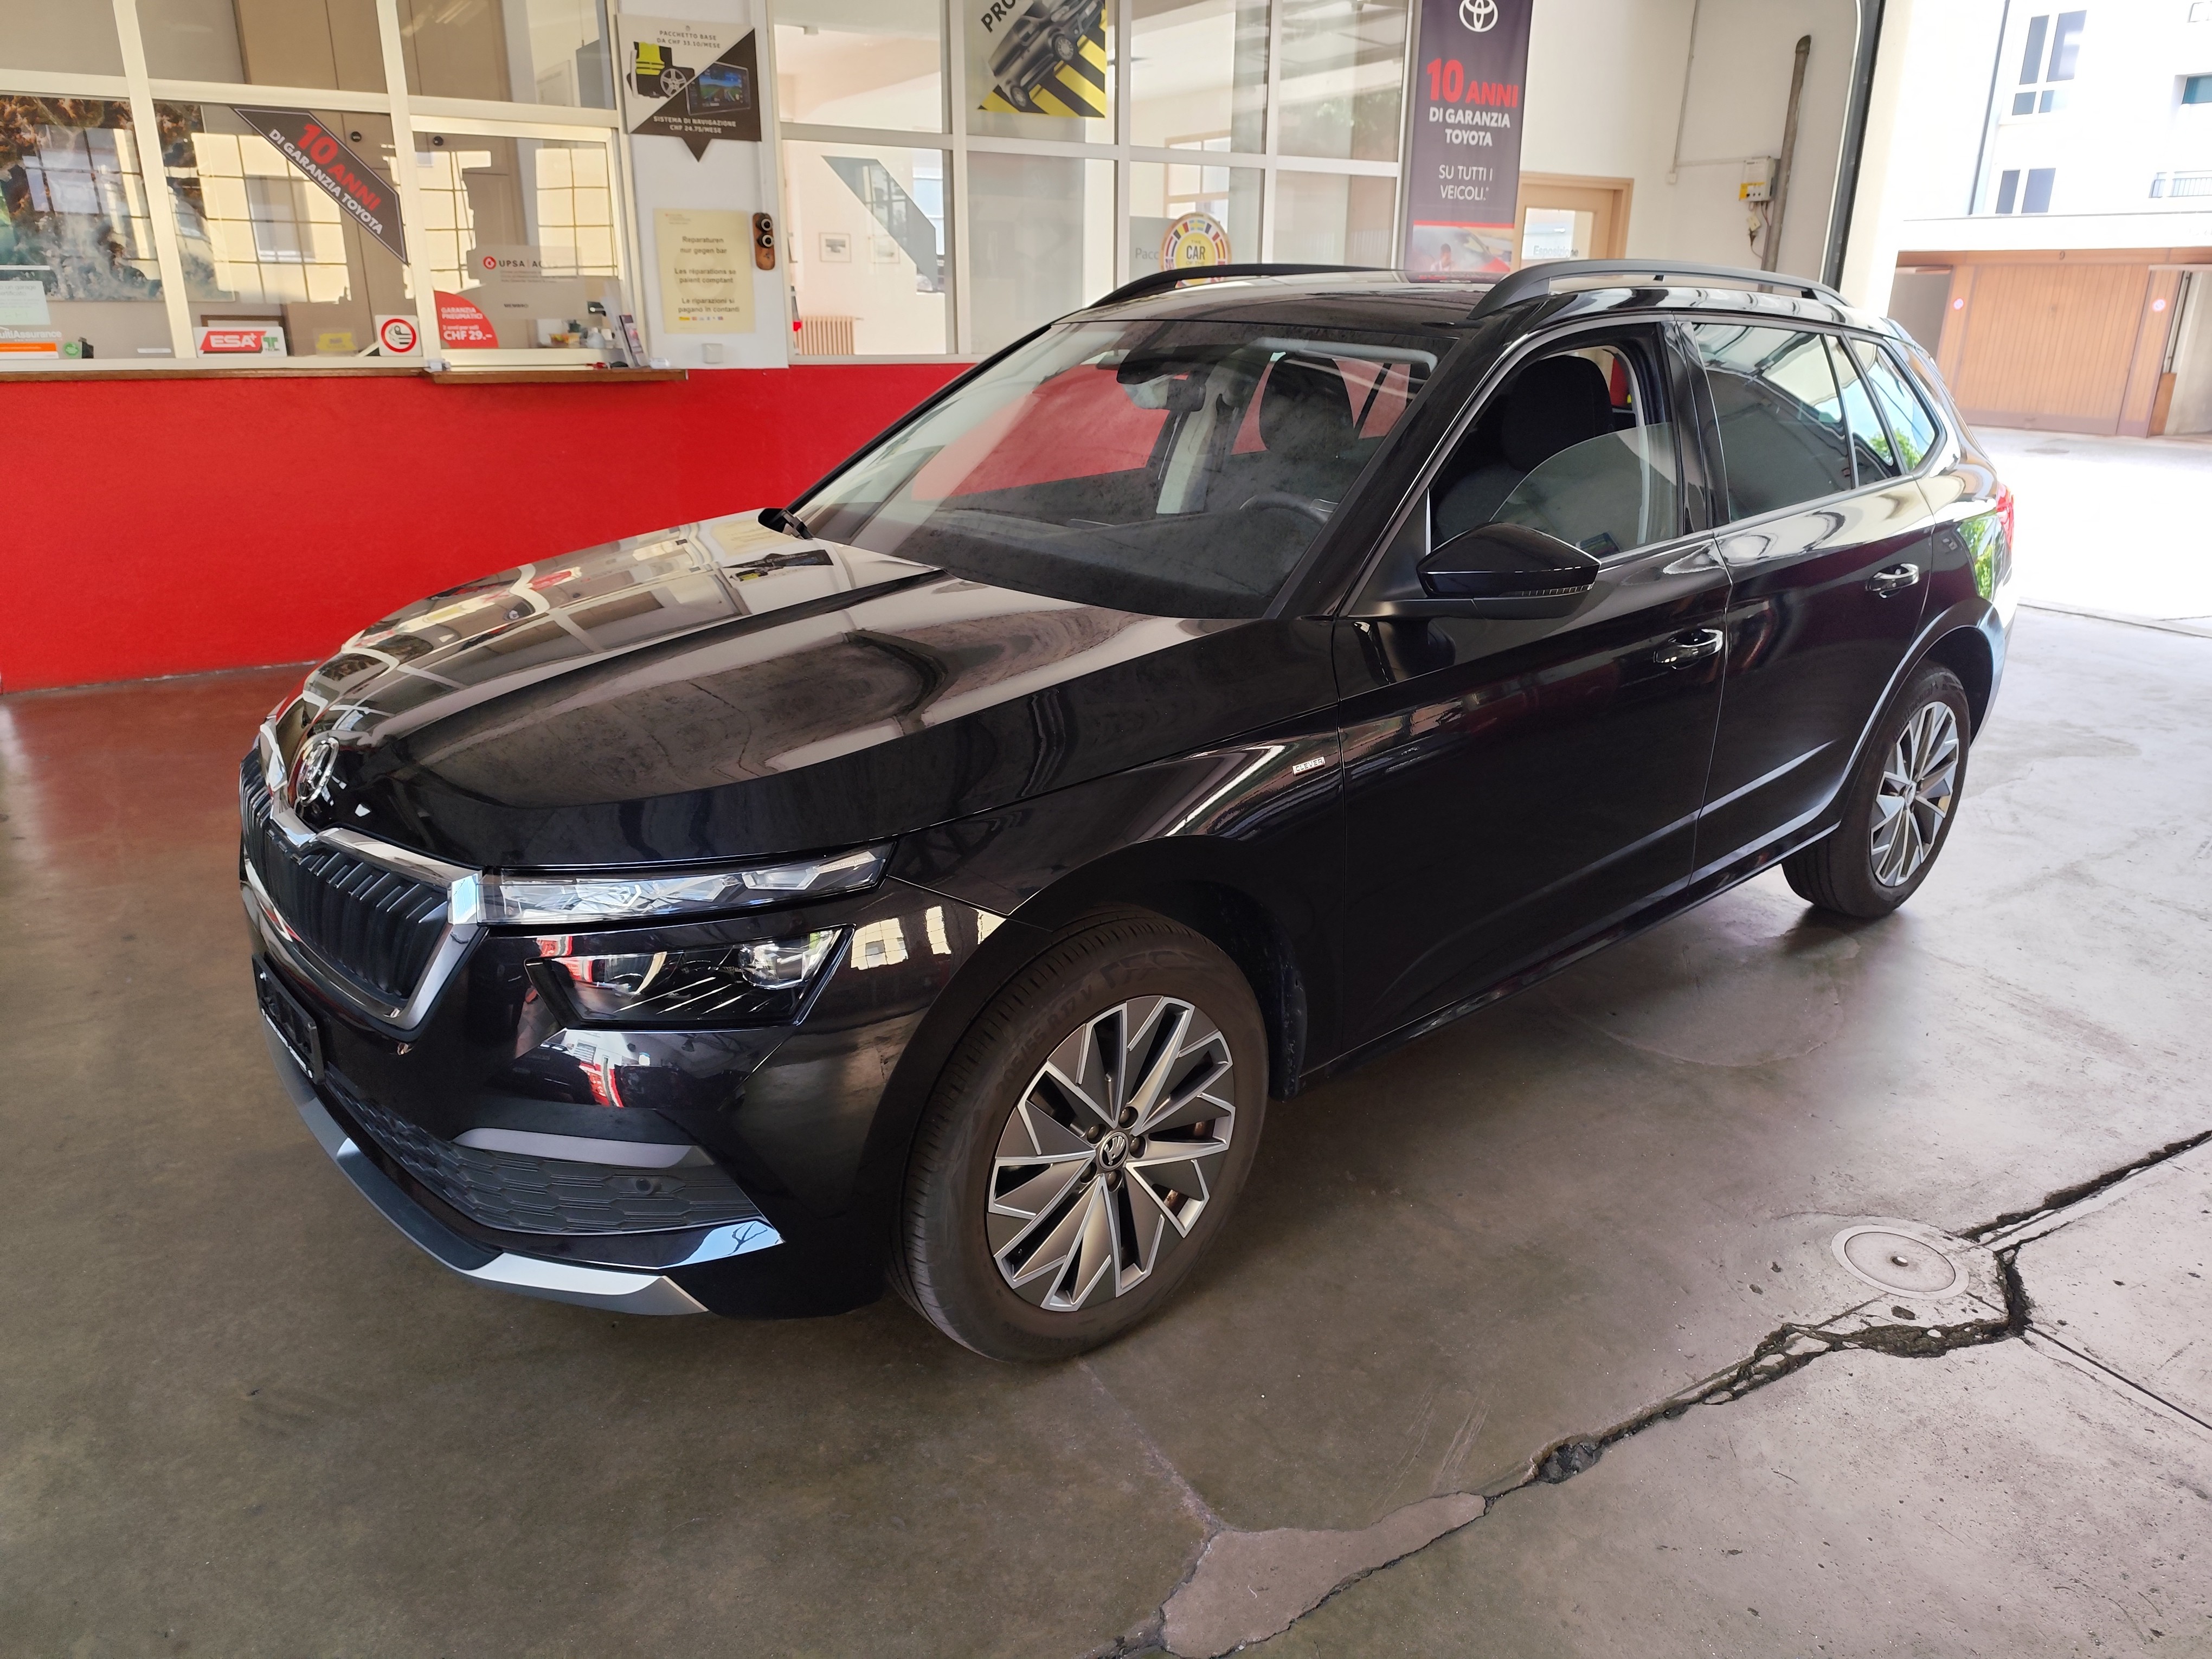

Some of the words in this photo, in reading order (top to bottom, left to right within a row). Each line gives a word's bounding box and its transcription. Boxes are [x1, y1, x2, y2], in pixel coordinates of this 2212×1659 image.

[659, 30, 698, 39] PACCHETTO
[1426, 57, 1464, 103] 10
[1465, 80, 1518, 108] ANNI
[653, 115, 682, 124] SISTEMA
[1429, 106, 1443, 123] DI
[1445, 108, 1510, 128] GARANZIA
[1444, 128, 1493, 147] TOYOTA
[297, 123, 339, 164] 10
[326, 163, 382, 211] ANNI
[1438, 164, 1455, 180] SU
[1457, 165, 1487, 182] TUTTI
[1489, 168, 1493, 182] I
[268, 128, 286, 145] DI
[283, 143, 342, 197] GARANZIA
[342, 193, 383, 235] TOYOTA
[1186, 245, 1206, 260] CAR
[498, 260, 525, 268] UPSA
[443, 330, 467, 340] CHF
[1295, 758, 1323, 771] CLEVER
